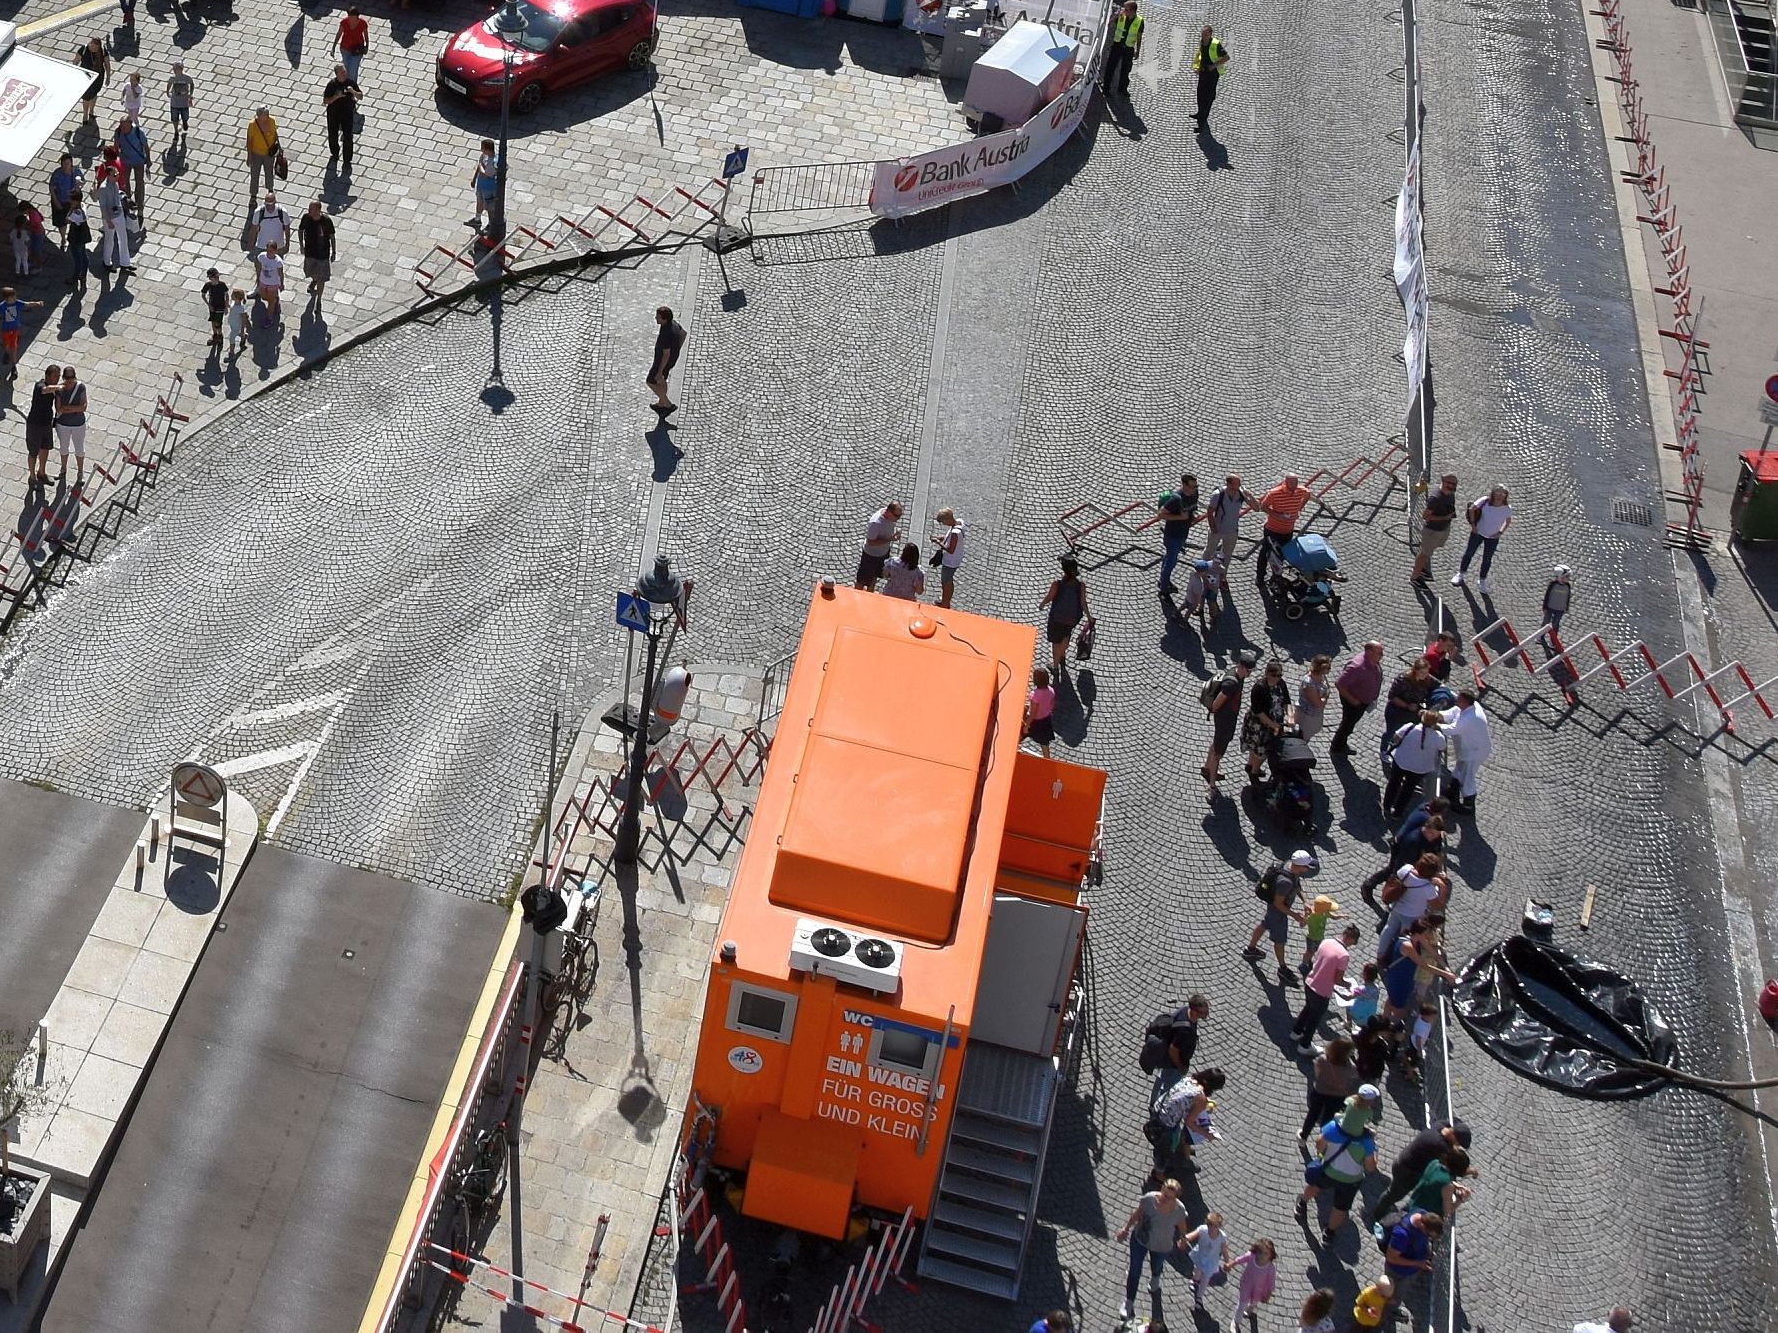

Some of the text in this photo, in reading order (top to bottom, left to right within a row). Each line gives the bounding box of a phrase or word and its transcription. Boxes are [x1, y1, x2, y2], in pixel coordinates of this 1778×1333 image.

[919, 135, 1030, 186] Bank Austria
[844, 1010, 874, 1028] WC
[822, 1078, 937, 1122] FÜR GROSS
[826, 1056, 944, 1101] EIN WAGEN
[818, 1101, 862, 1127] UND
